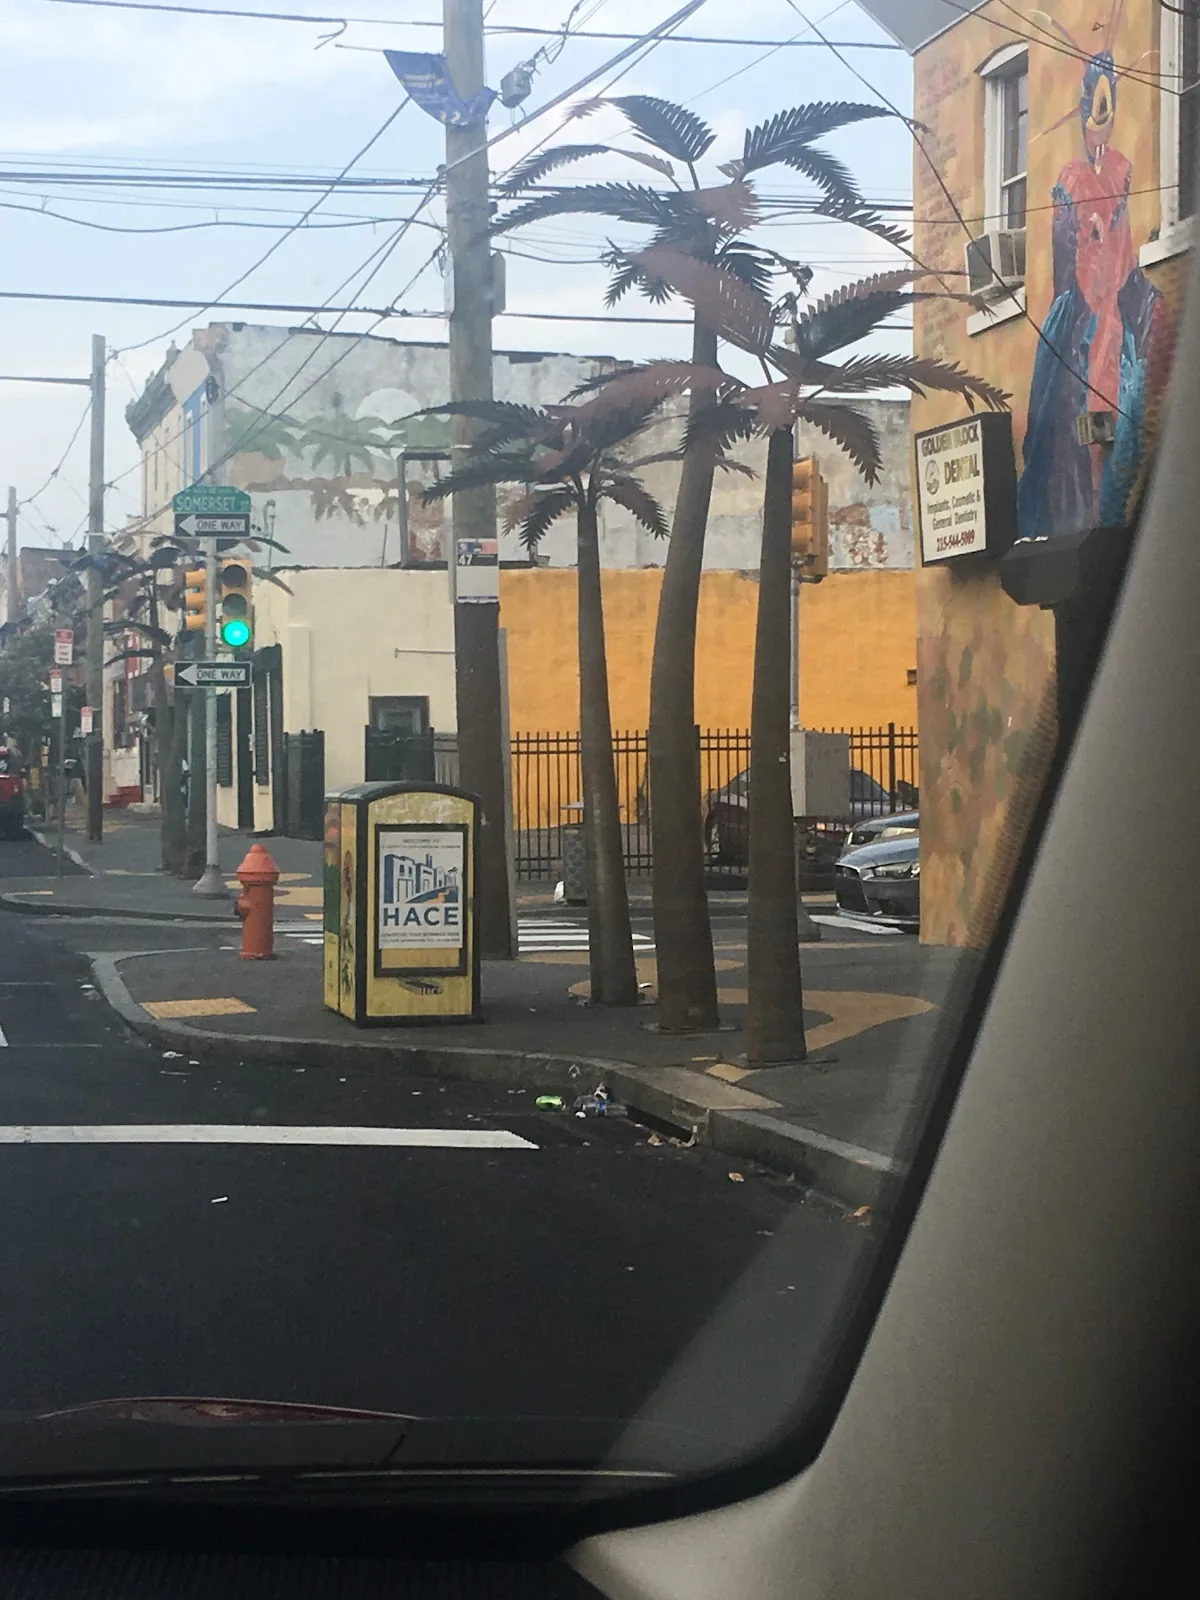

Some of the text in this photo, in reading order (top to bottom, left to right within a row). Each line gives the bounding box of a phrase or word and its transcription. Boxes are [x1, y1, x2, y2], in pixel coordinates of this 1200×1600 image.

[944, 453, 980, 485] DENTAL
[176, 495, 236, 511] SOMERSET
[196, 520, 242, 530] ONE WAY
[196, 669, 242, 680] ONE WAY
[383, 906, 459, 927] HACE
